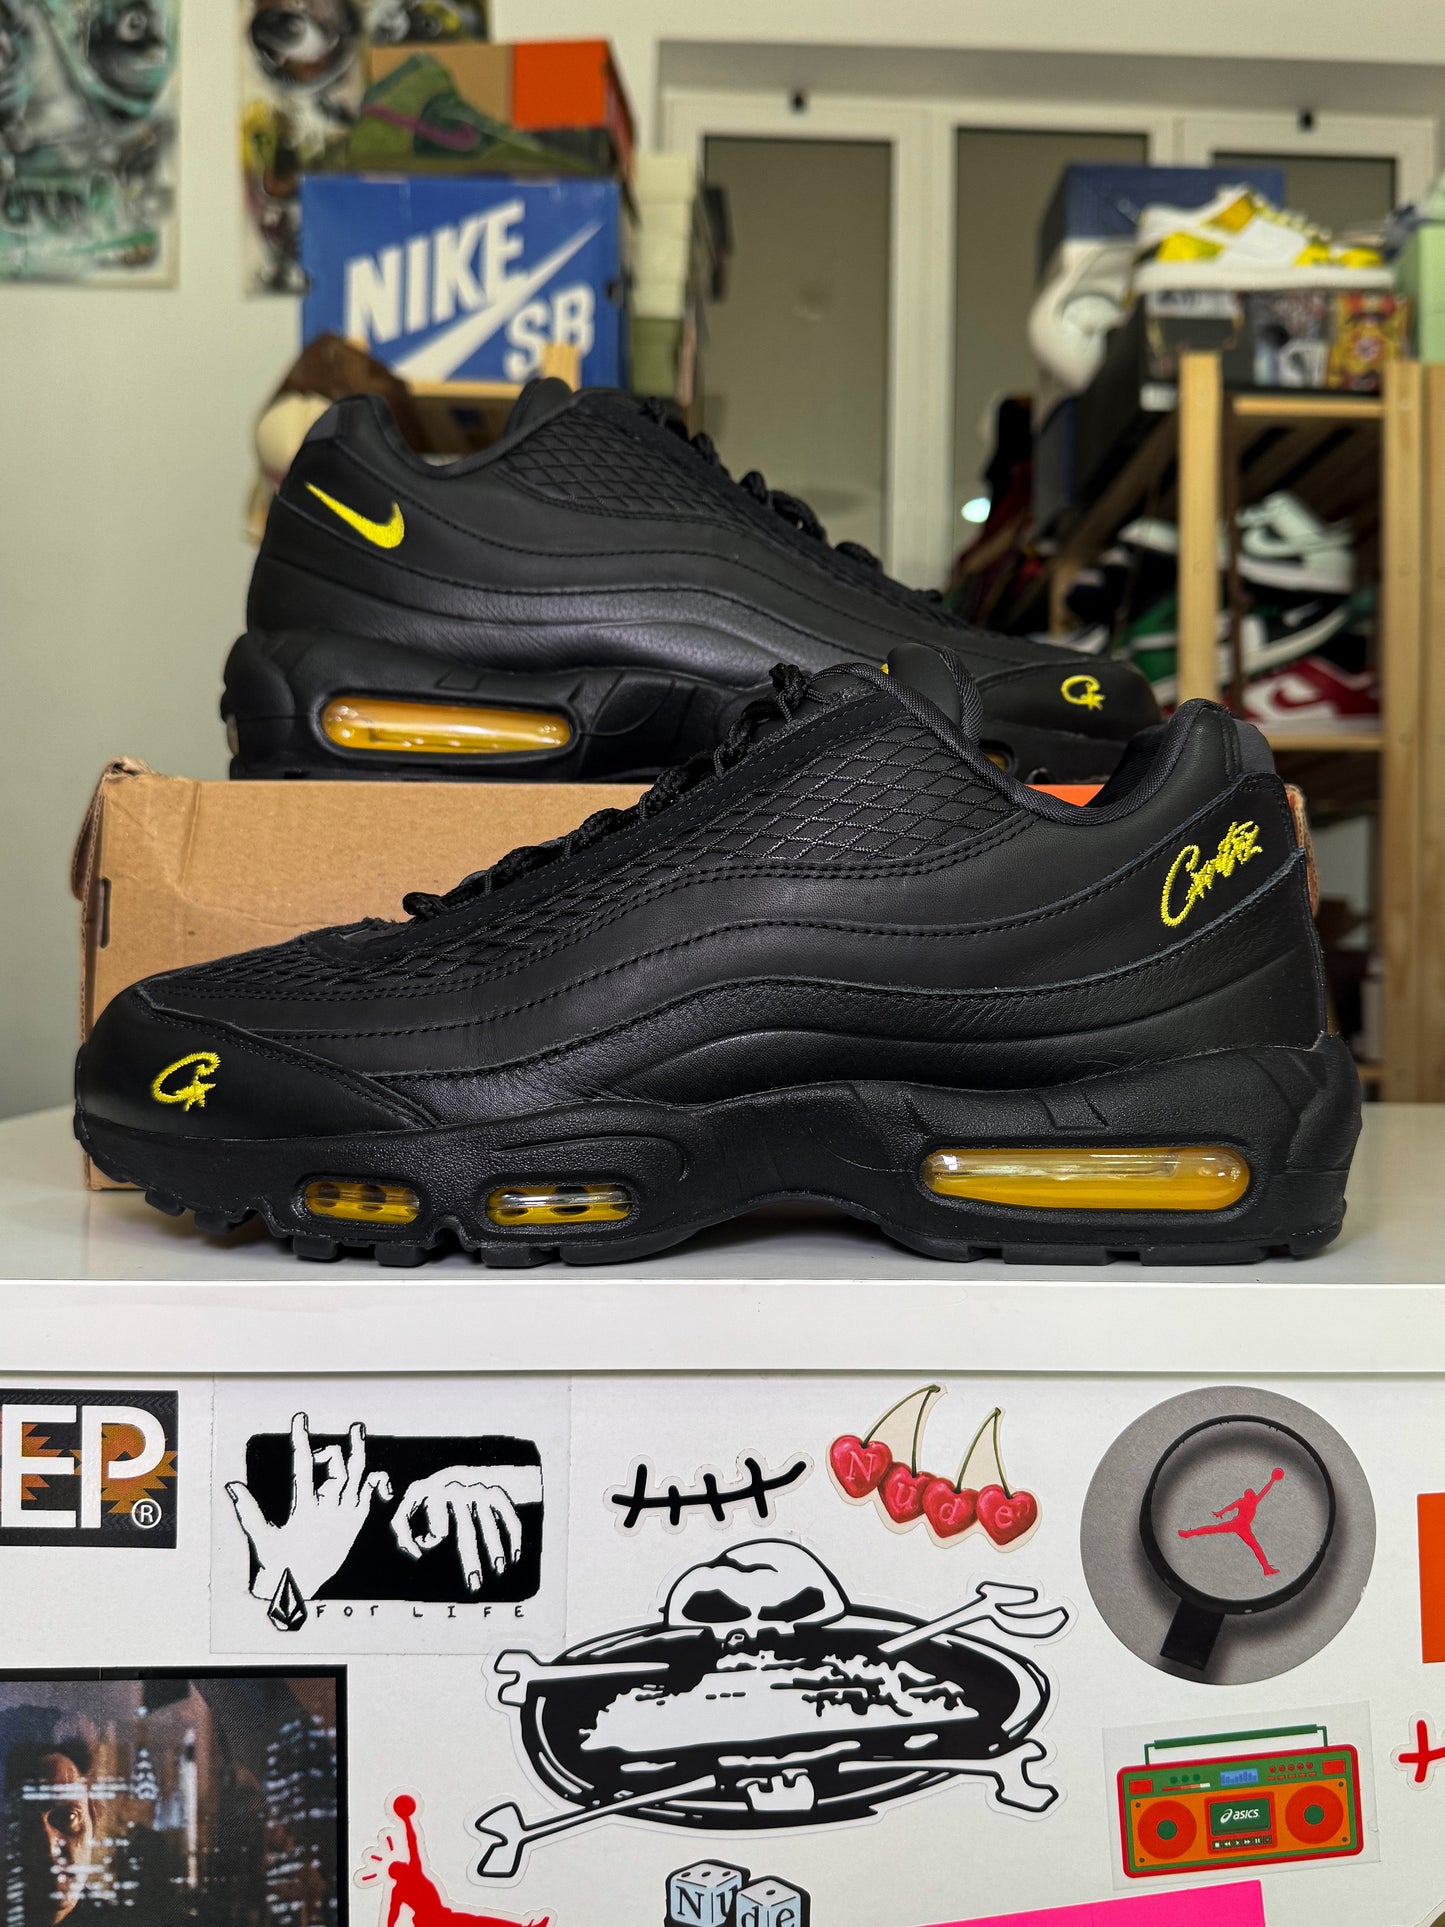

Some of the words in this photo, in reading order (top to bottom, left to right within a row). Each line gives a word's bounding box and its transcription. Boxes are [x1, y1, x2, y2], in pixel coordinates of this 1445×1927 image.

[345, 197, 525, 345] NIKE
[502, 282, 596, 383] SB
[845, 1450, 1015, 1530] Nude
[412, 1605, 524, 1618] LIFE
